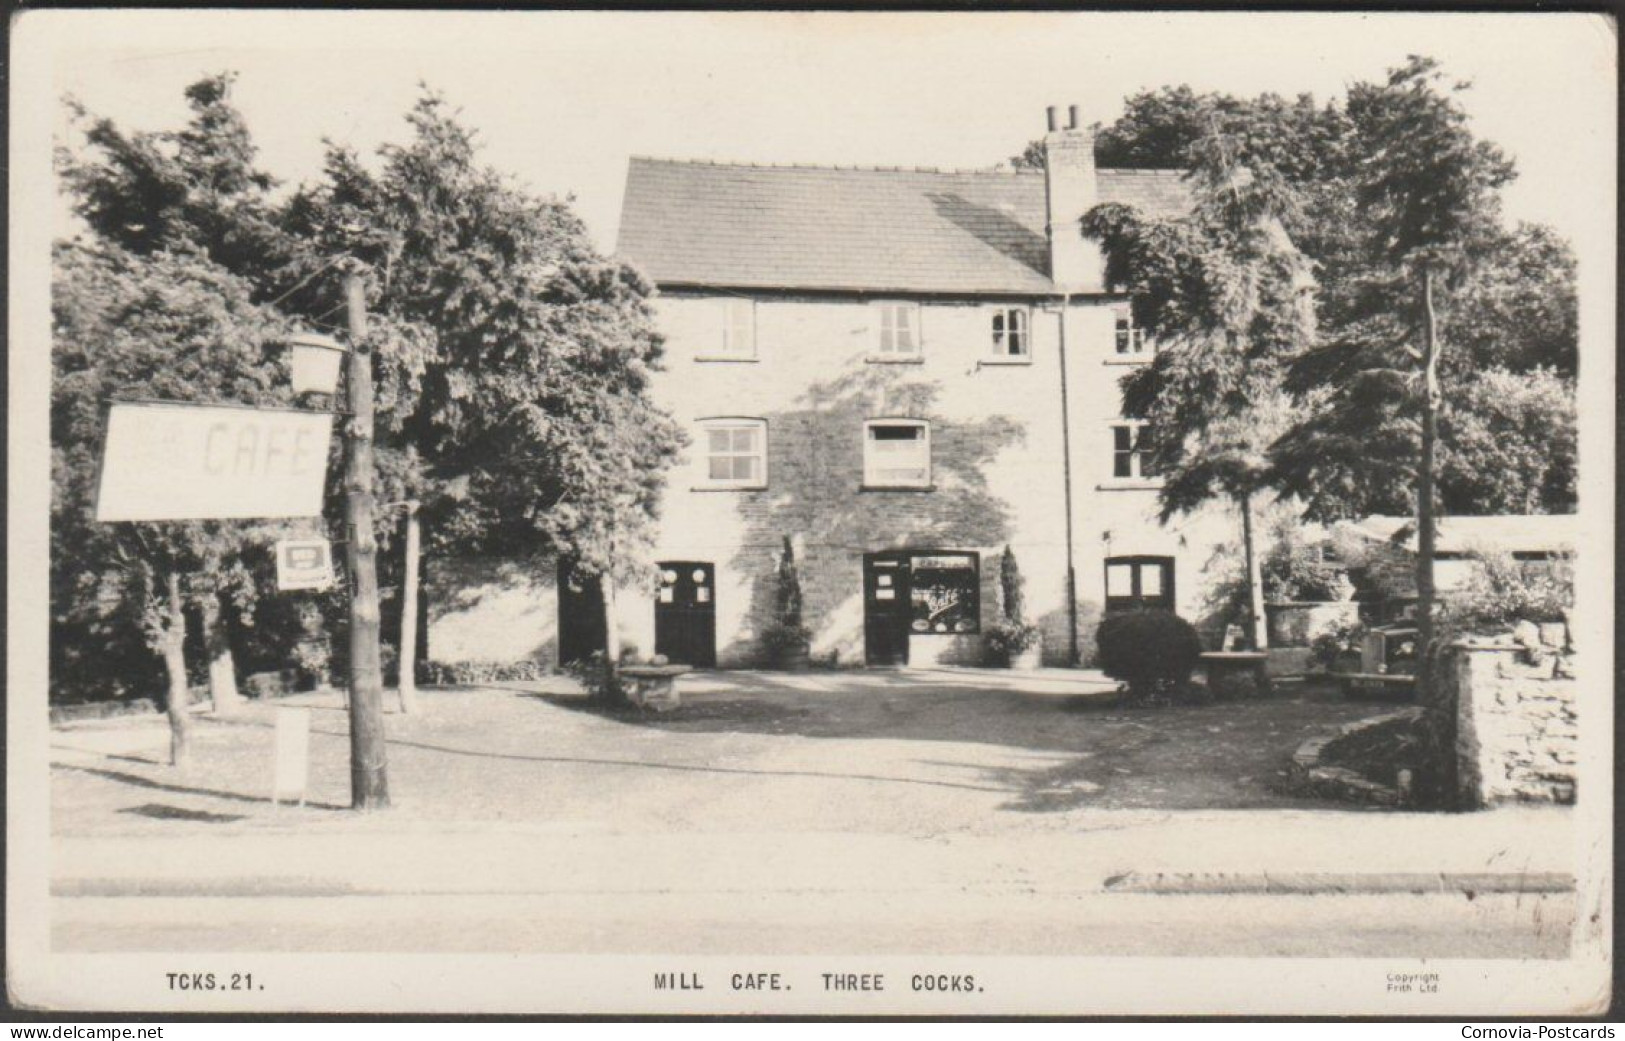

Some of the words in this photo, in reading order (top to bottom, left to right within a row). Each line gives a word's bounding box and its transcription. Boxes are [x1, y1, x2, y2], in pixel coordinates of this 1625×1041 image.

[203, 422, 313, 476] CAFE
[166, 974, 265, 991] TCKS.21.
[654, 973, 704, 990] MILL
[732, 973, 792, 991] CAFE.
[822, 974, 884, 991] THREE
[911, 975, 985, 993] COCKS.
[1386, 973, 1440, 983] Copyright
[1387, 984, 1412, 993] Frith
[1420, 984, 1438, 993] Ltd
